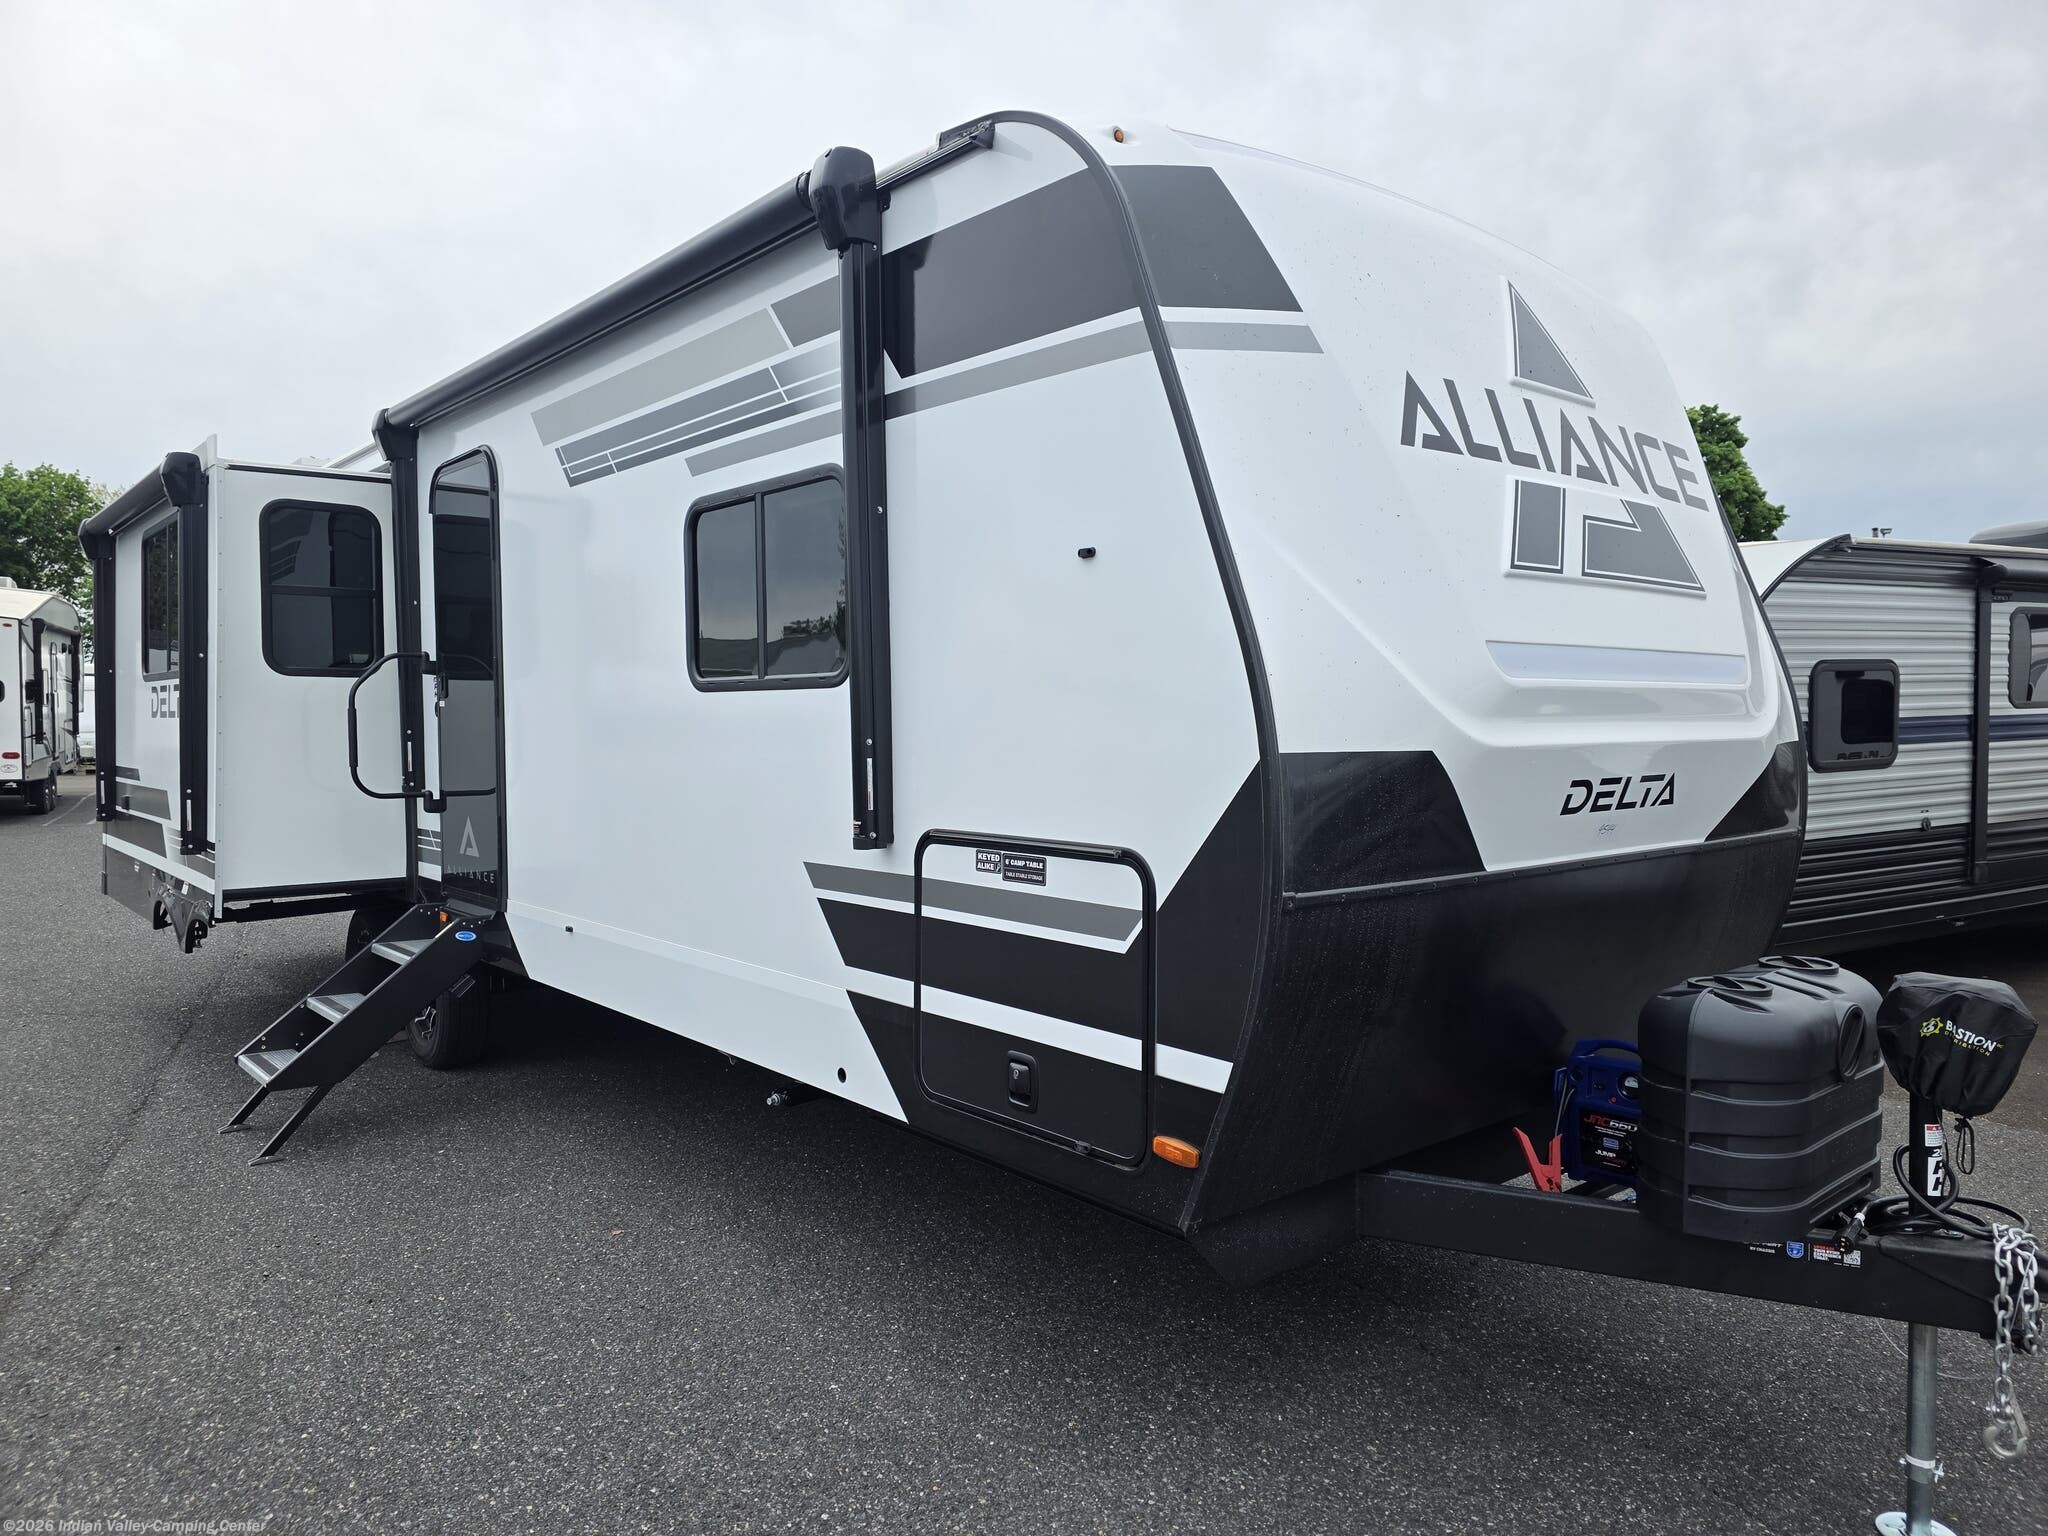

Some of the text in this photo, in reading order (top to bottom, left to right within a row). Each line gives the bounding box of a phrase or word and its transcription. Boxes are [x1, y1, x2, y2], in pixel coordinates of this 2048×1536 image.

[1400, 370, 1709, 512] ALLIANCE
[1559, 772, 1675, 816] DELTA
[977, 852, 1000, 862] KEYED
[1010, 859, 1026, 867] CAMP
[1025, 860, 1044, 869] TABLE
[977, 862, 995, 870] ALIKE
[446, 864, 495, 884] ALLIANCE
